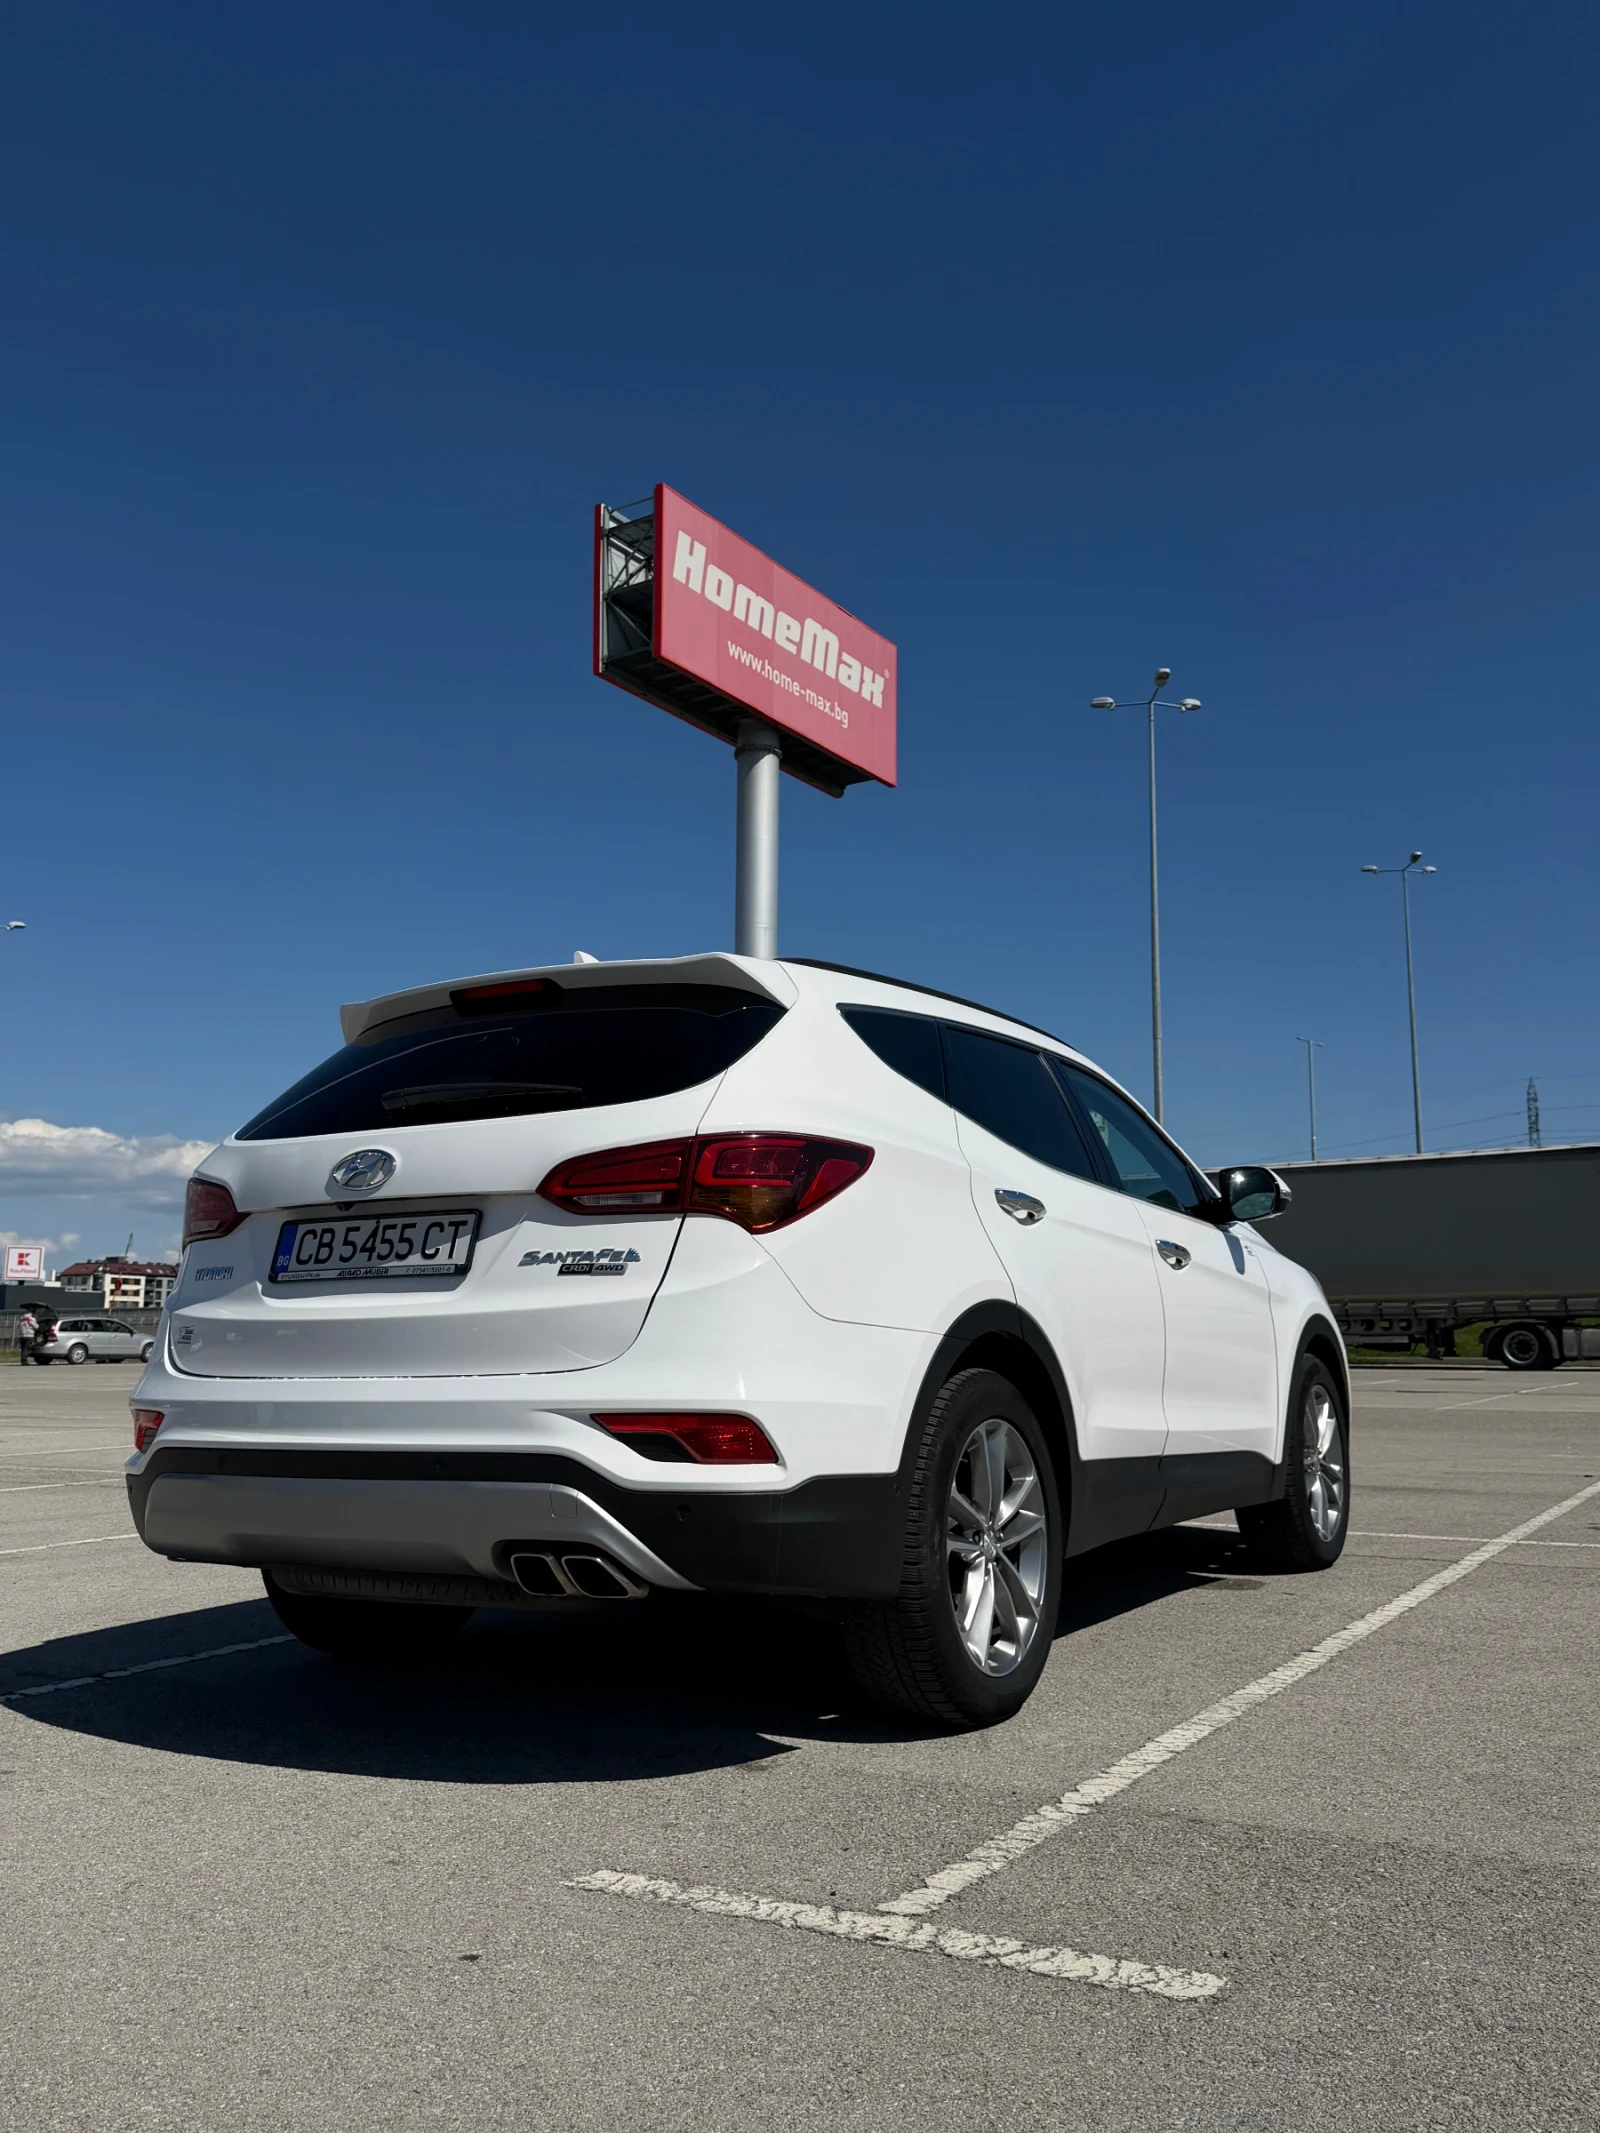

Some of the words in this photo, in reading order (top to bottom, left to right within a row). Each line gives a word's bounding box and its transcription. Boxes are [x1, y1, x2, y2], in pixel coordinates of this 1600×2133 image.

[673, 530, 885, 708] HomeMax
[728, 640, 849, 729] www.home-max.bg
[277, 1255, 290, 1267] BG
[295, 1227, 336, 1265] CB
[338, 1222, 417, 1263] 5455
[421, 1220, 468, 1260] CT
[562, 1264, 591, 1272] CRDi
[595, 1264, 624, 1272] 4WD
